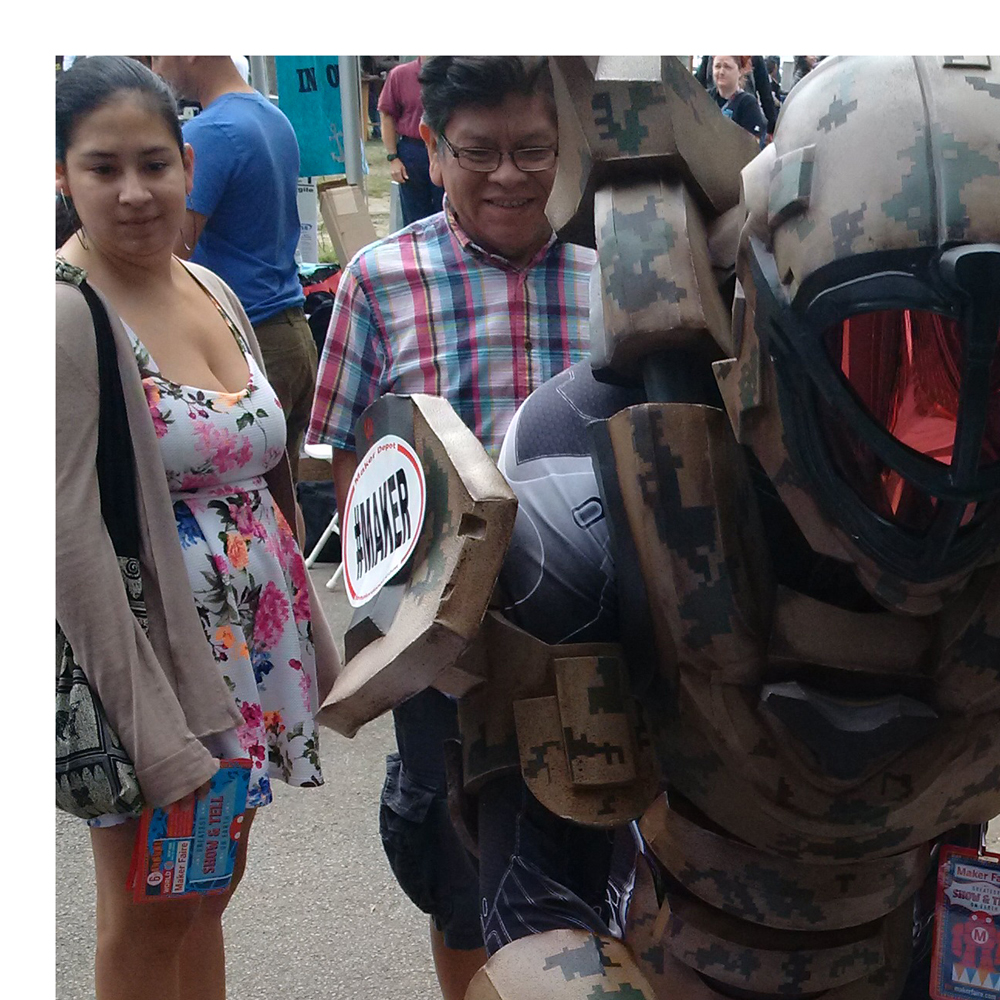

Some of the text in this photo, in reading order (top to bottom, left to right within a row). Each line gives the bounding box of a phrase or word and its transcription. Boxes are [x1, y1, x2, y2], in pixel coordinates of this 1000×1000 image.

[296, 67, 318, 92] IN
[355, 442, 396, 484] Maker Depot
[354, 468, 411, 580] #MAKER
[203, 796, 224, 875] SHOW & TELL
[175, 842, 189, 891] Maker Faire
[956, 866, 988, 880] Maker
[164, 870, 172, 893] WORLD
[952, 889, 980, 903] SHOW
[982, 894, 991, 905] &
[954, 986, 997, 1000] makerfaire.com
